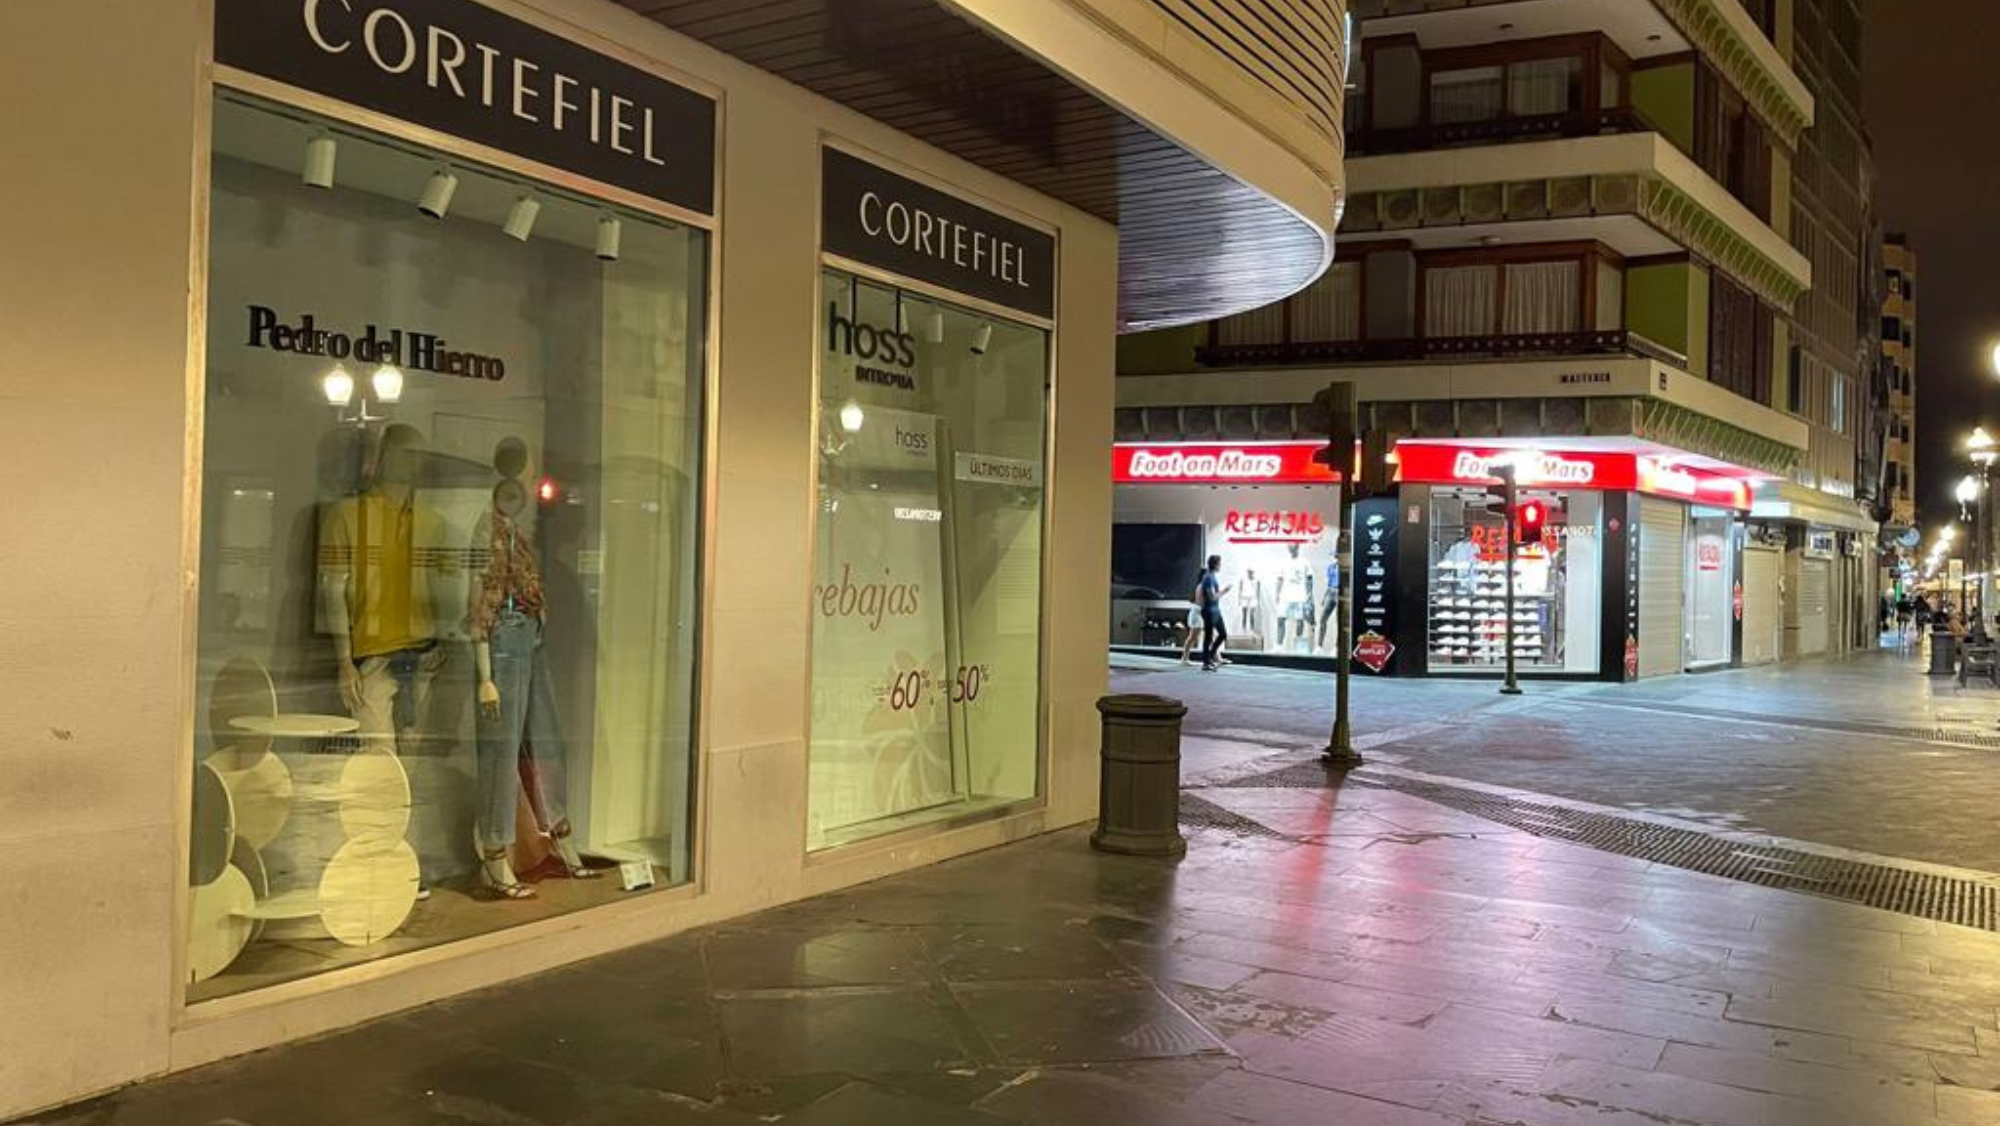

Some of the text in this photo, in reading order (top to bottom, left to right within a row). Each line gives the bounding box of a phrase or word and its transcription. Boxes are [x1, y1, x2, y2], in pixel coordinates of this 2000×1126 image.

[303, 0, 666, 166] CORTEFIEL
[860, 192, 1030, 288] CORTEFIEL
[246, 304, 505, 382] Pedro del Hierro
[828, 301, 915, 368] hoss
[1133, 453, 1279, 474] Foot on Mars
[1543, 460, 1590, 478] Mars
[1225, 509, 1325, 535] REBAJAS
[814, 563, 919, 632] rebajas
